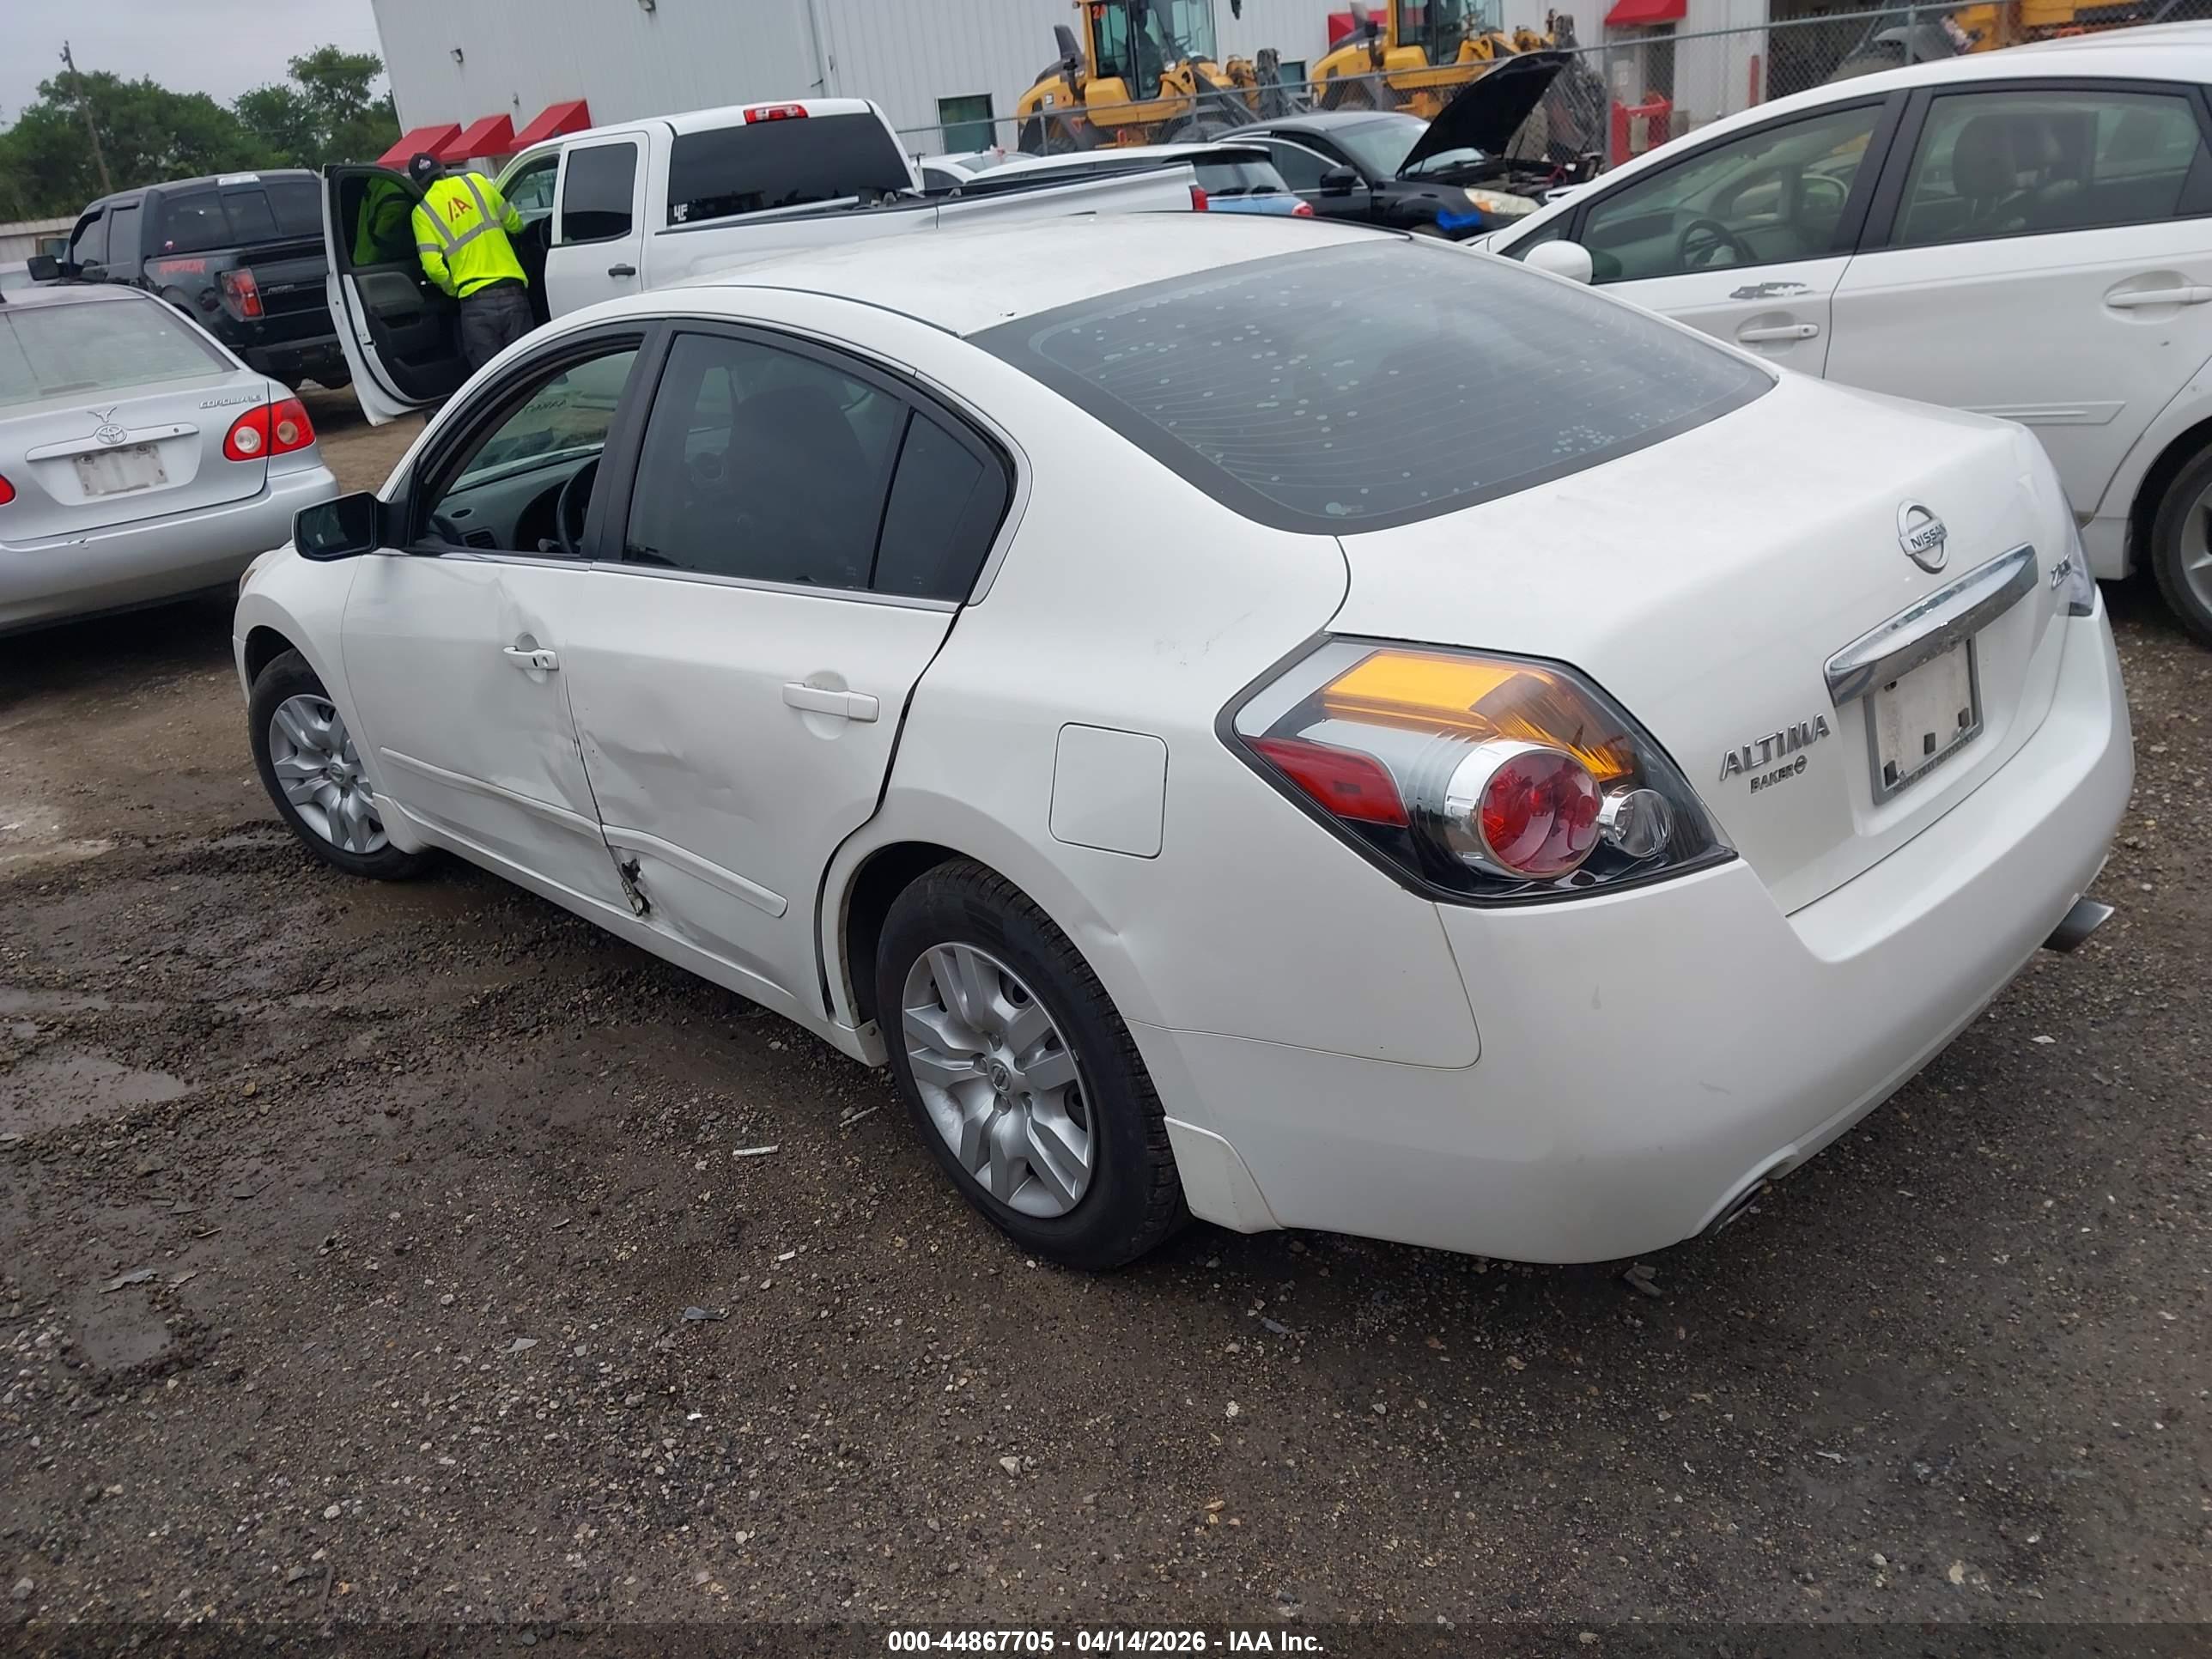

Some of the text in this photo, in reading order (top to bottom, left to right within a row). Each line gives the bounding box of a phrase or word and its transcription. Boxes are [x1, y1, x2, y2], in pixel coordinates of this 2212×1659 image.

[1910, 523, 1947, 550] NISSAN
[1719, 713, 1831, 781] ALTIMA
[1750, 763, 1795, 794] BAKER
